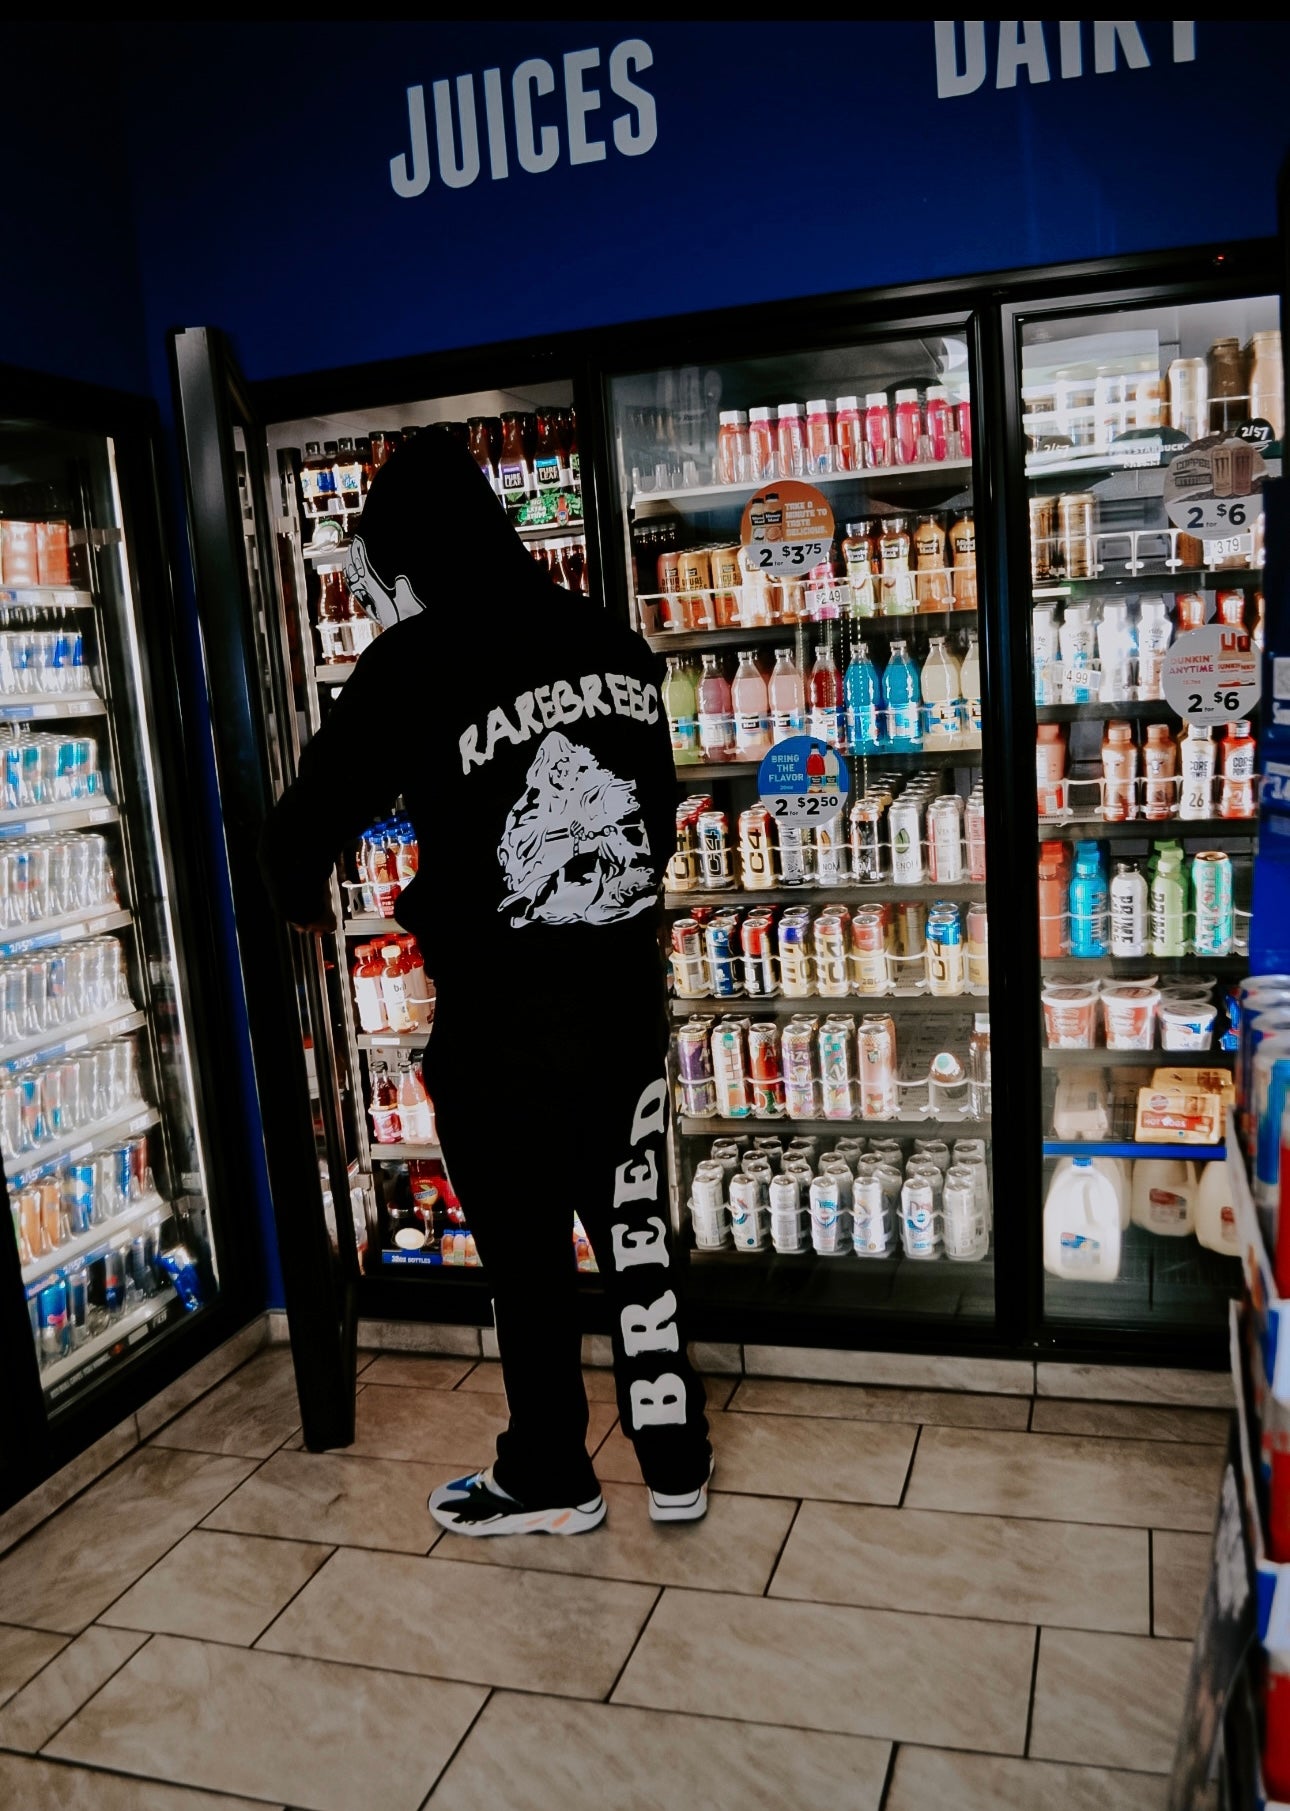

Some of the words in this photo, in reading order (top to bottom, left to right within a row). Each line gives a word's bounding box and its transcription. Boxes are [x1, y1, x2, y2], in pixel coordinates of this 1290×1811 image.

[389, 38, 657, 198] JUICES
[1187, 507, 1204, 528] 2
[1216, 503, 1246, 526] $6
[759, 549, 773, 567] 2
[1188, 693, 1203, 713] 2
[1213, 691, 1240, 711] $6
[771, 754, 800, 763] BRING
[777, 764, 795, 772] THE
[769, 773, 804, 783] FLAVOR
[775, 798, 788, 816] 2
[1189, 792, 1205, 808] 26
[747, 828, 765, 874] C4
[613, 1077, 687, 1431] BREED
